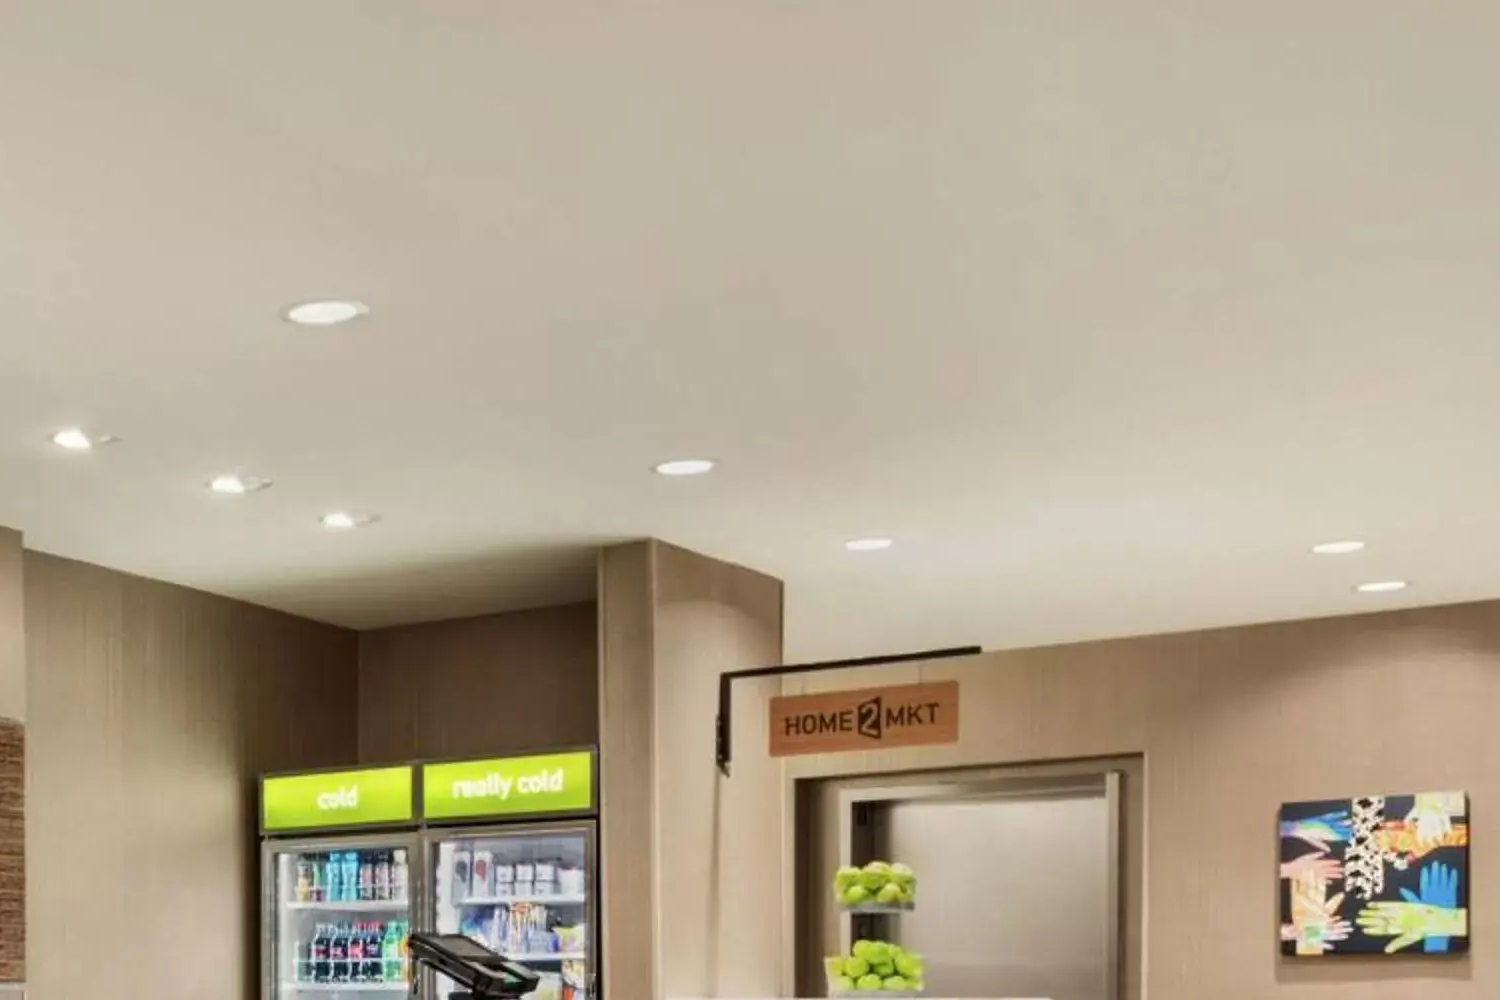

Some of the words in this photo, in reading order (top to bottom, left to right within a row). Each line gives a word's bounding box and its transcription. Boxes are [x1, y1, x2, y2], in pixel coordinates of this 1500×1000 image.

[317, 785, 359, 810] cold
[452, 773, 512, 801] really
[518, 768, 564, 794] cold
